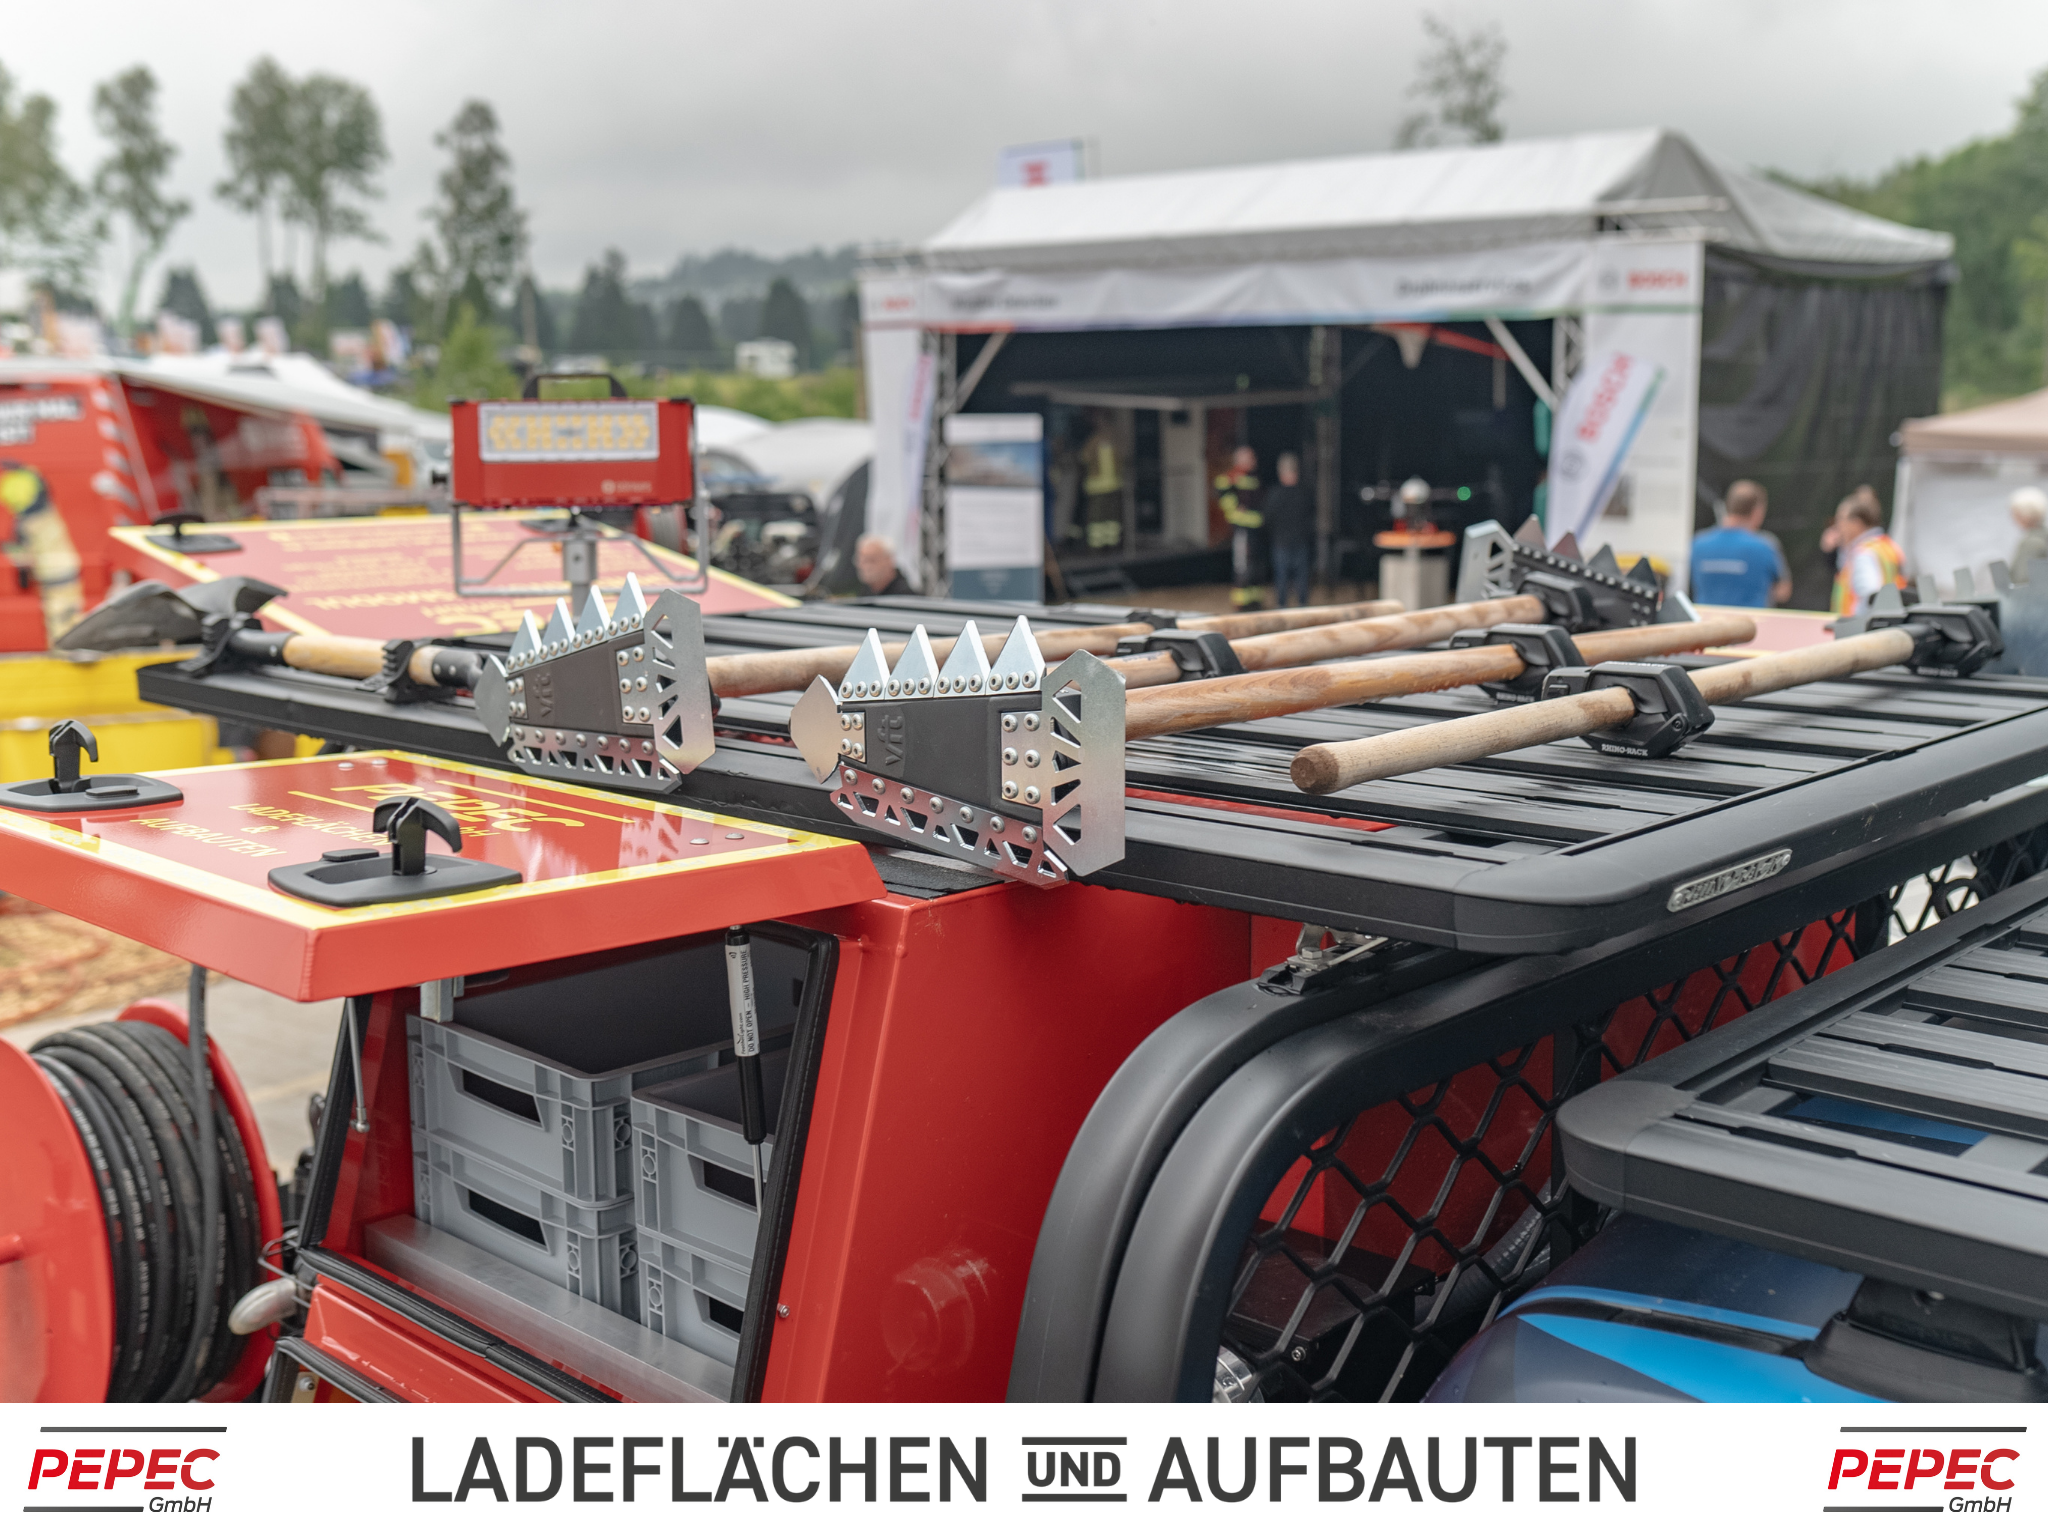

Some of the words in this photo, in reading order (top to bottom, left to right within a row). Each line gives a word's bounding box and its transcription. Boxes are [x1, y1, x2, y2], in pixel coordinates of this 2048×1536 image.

[1601, 743, 1649, 757] RHINO-RACK
[240, 825, 280, 834] &
[129, 817, 288, 858] AUFBAUTEN
[741, 950, 749, 982] PRESSURE
[745, 1010, 753, 1027] OPEN
[748, 1044, 755, 1053] DO
